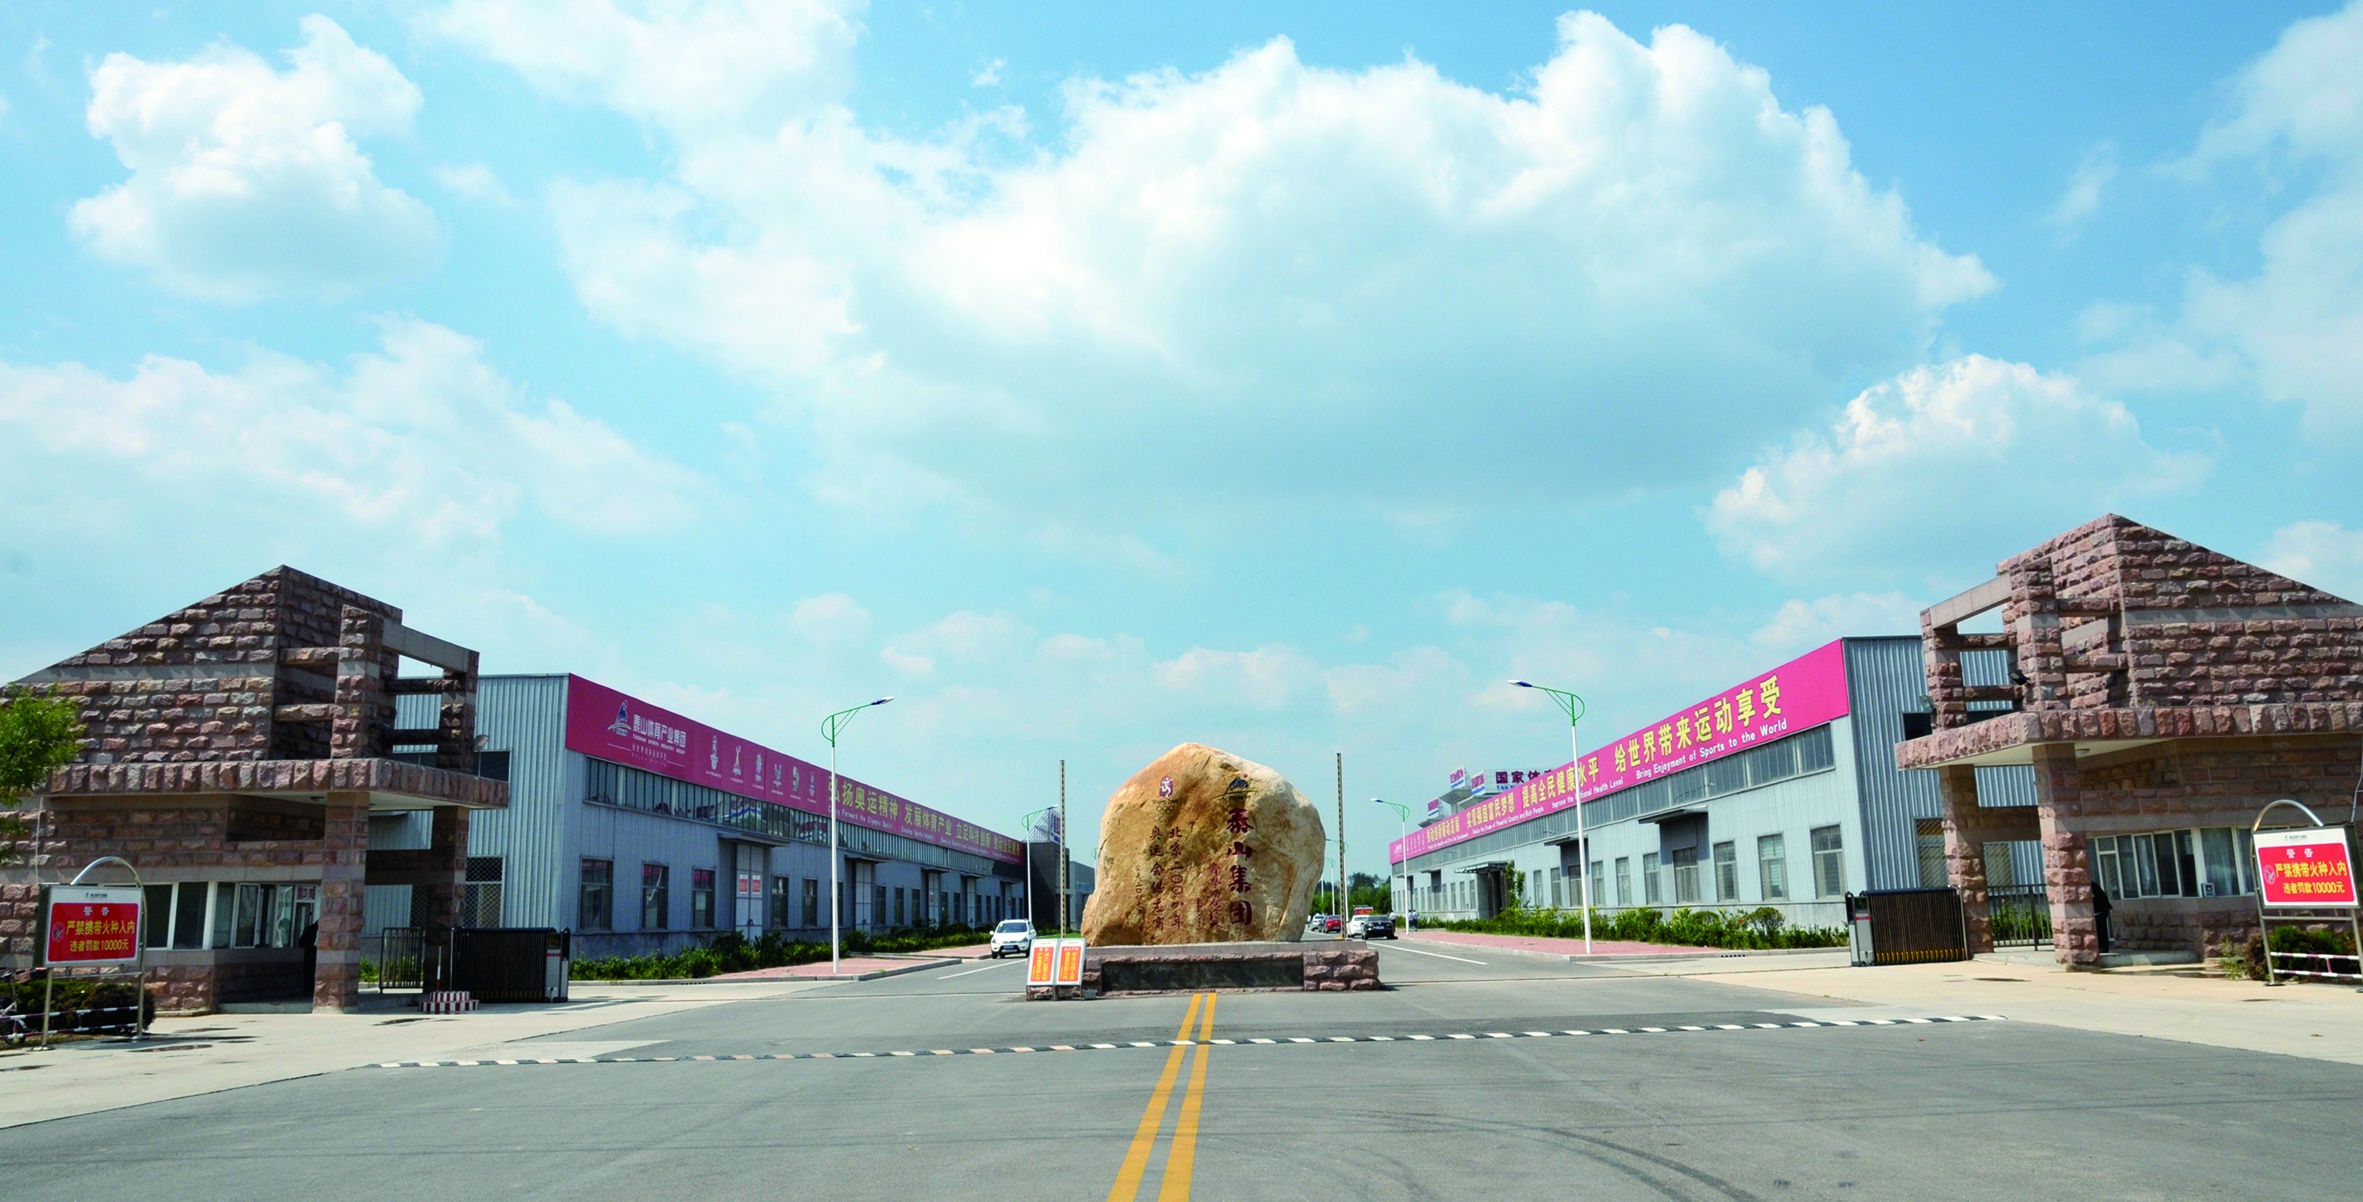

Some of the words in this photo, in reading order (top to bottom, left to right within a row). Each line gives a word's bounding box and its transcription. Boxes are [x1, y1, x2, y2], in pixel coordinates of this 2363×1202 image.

[633, 714, 687, 748] 泰山体育产业集团
[1466, 792, 1515, 829] 实现强国富民梦想
[1521, 756, 1599, 808] 提高全民健康水平
[1614, 674, 1782, 773] 给世界带来运动享受
[1533, 806, 1544, 816] People
[1552, 799, 1566, 809] Improve
[1593, 781, 1608, 794] Health
[1610, 776, 1623, 789] Level
[1636, 766, 1652, 780] Bring
[1654, 756, 1686, 774] Enjoyment
[1689, 749, 1697, 762] of
[1700, 742, 1725, 758] Sports
[1728, 738, 1738, 749] to
[1741, 731, 1756, 743] the
[1760, 717, 1787, 737] World
[1495, 769, 1552, 784] 国家体
[842, 809, 858, 819] Forward
[904, 804, 951, 836] 发展体育产业
[2286, 848, 2313, 858] 警告
[1227, 806, 1254, 925] 泰山集团
[2275, 860, 2347, 878] 严禁携带火种入内
[2283, 881, 2345, 894] 违者罚款10000元
[83, 906, 109, 916] 警告
[66, 920, 135, 936] 严禁携带火种入内
[70, 939, 129, 952] 违者罚款10000元
